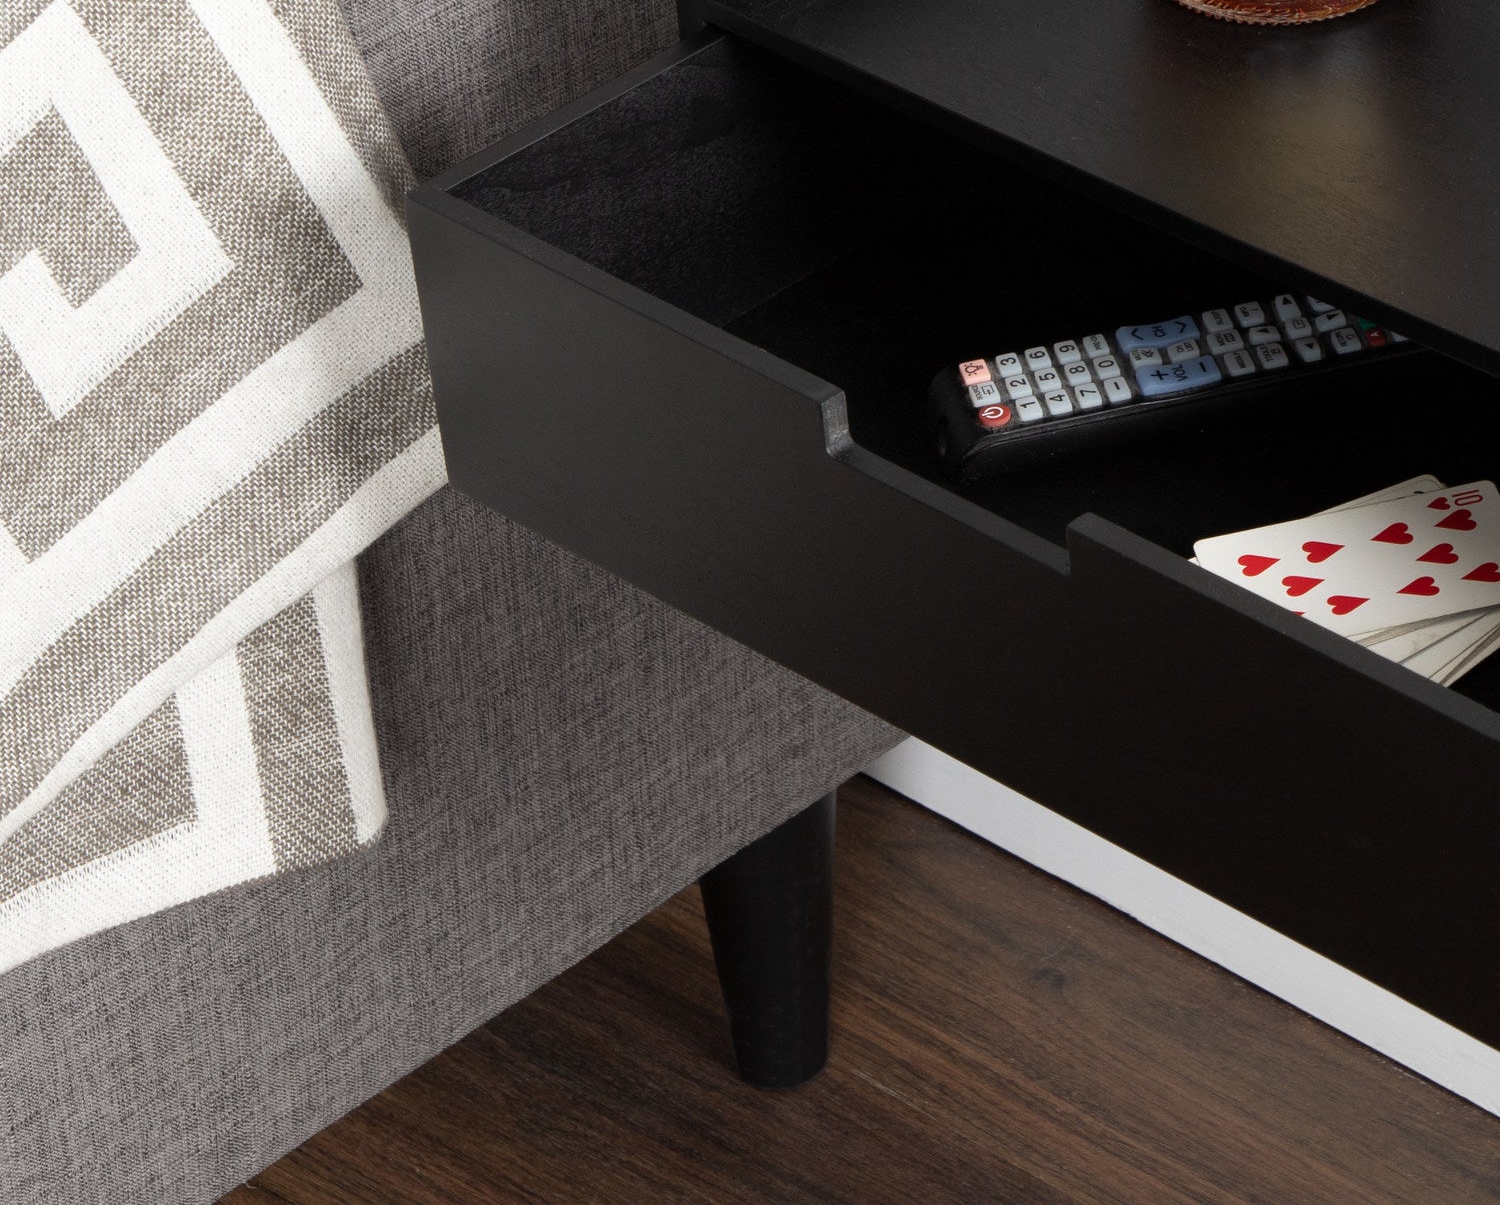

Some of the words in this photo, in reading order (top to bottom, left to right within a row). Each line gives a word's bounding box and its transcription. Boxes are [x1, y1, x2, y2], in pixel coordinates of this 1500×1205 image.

[1151, 325, 1167, 338] CH
[1059, 344, 1075, 353] 9
[1029, 350, 1046, 359] 6
[1000, 357, 1016, 366] 3
[1098, 359, 1114, 368] 0
[1069, 365, 1085, 374] 8
[1171, 364, 1188, 382] VOL
[1039, 372, 1056, 382] 5
[1010, 378, 1026, 388] 2
[1080, 389, 1097, 397] 7
[1049, 394, 1065, 402] 4
[1019, 401, 1036, 409] 1
[1451, 489, 1484, 506] 10
